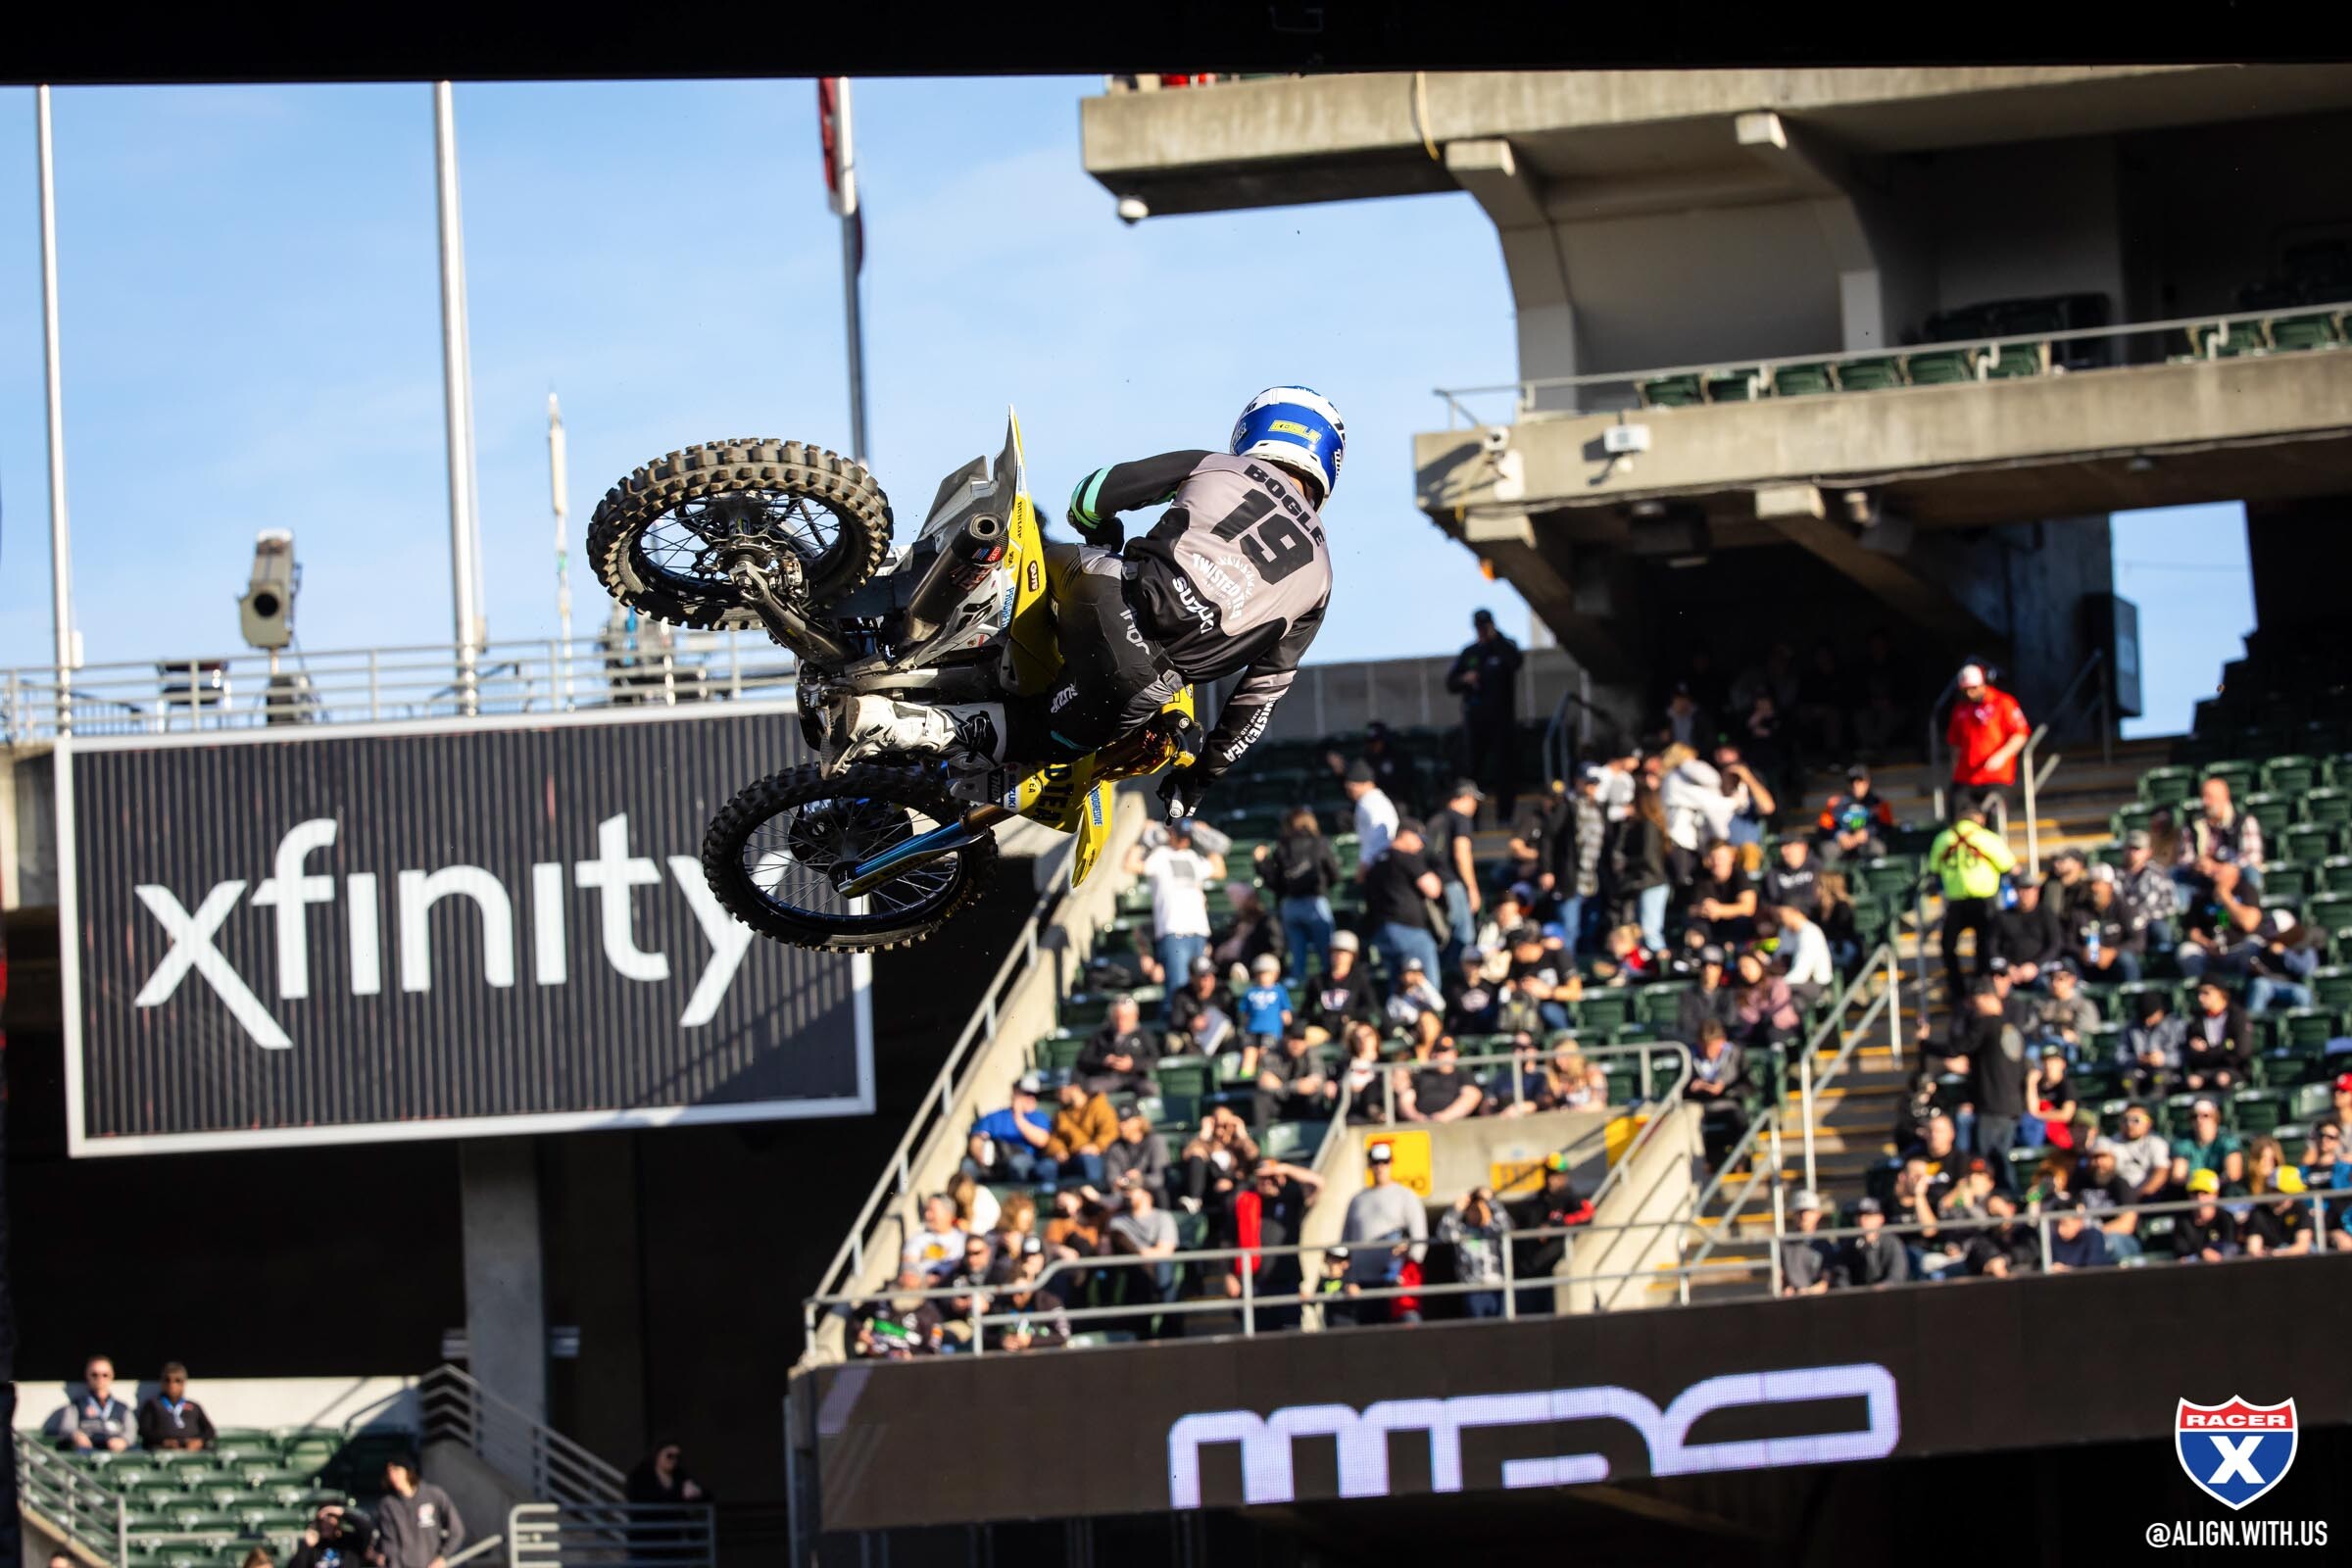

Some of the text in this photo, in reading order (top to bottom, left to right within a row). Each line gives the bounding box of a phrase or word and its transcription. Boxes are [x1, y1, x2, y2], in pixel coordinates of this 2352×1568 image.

[1209, 488, 1314, 585] 19
[1244, 464, 1325, 547] BOGLE
[1172, 576, 1214, 635] SUZUKI
[1192, 553, 1241, 597] TWISTED
[1223, 740, 1250, 762] TEA
[133, 811, 792, 1050] xfinity
